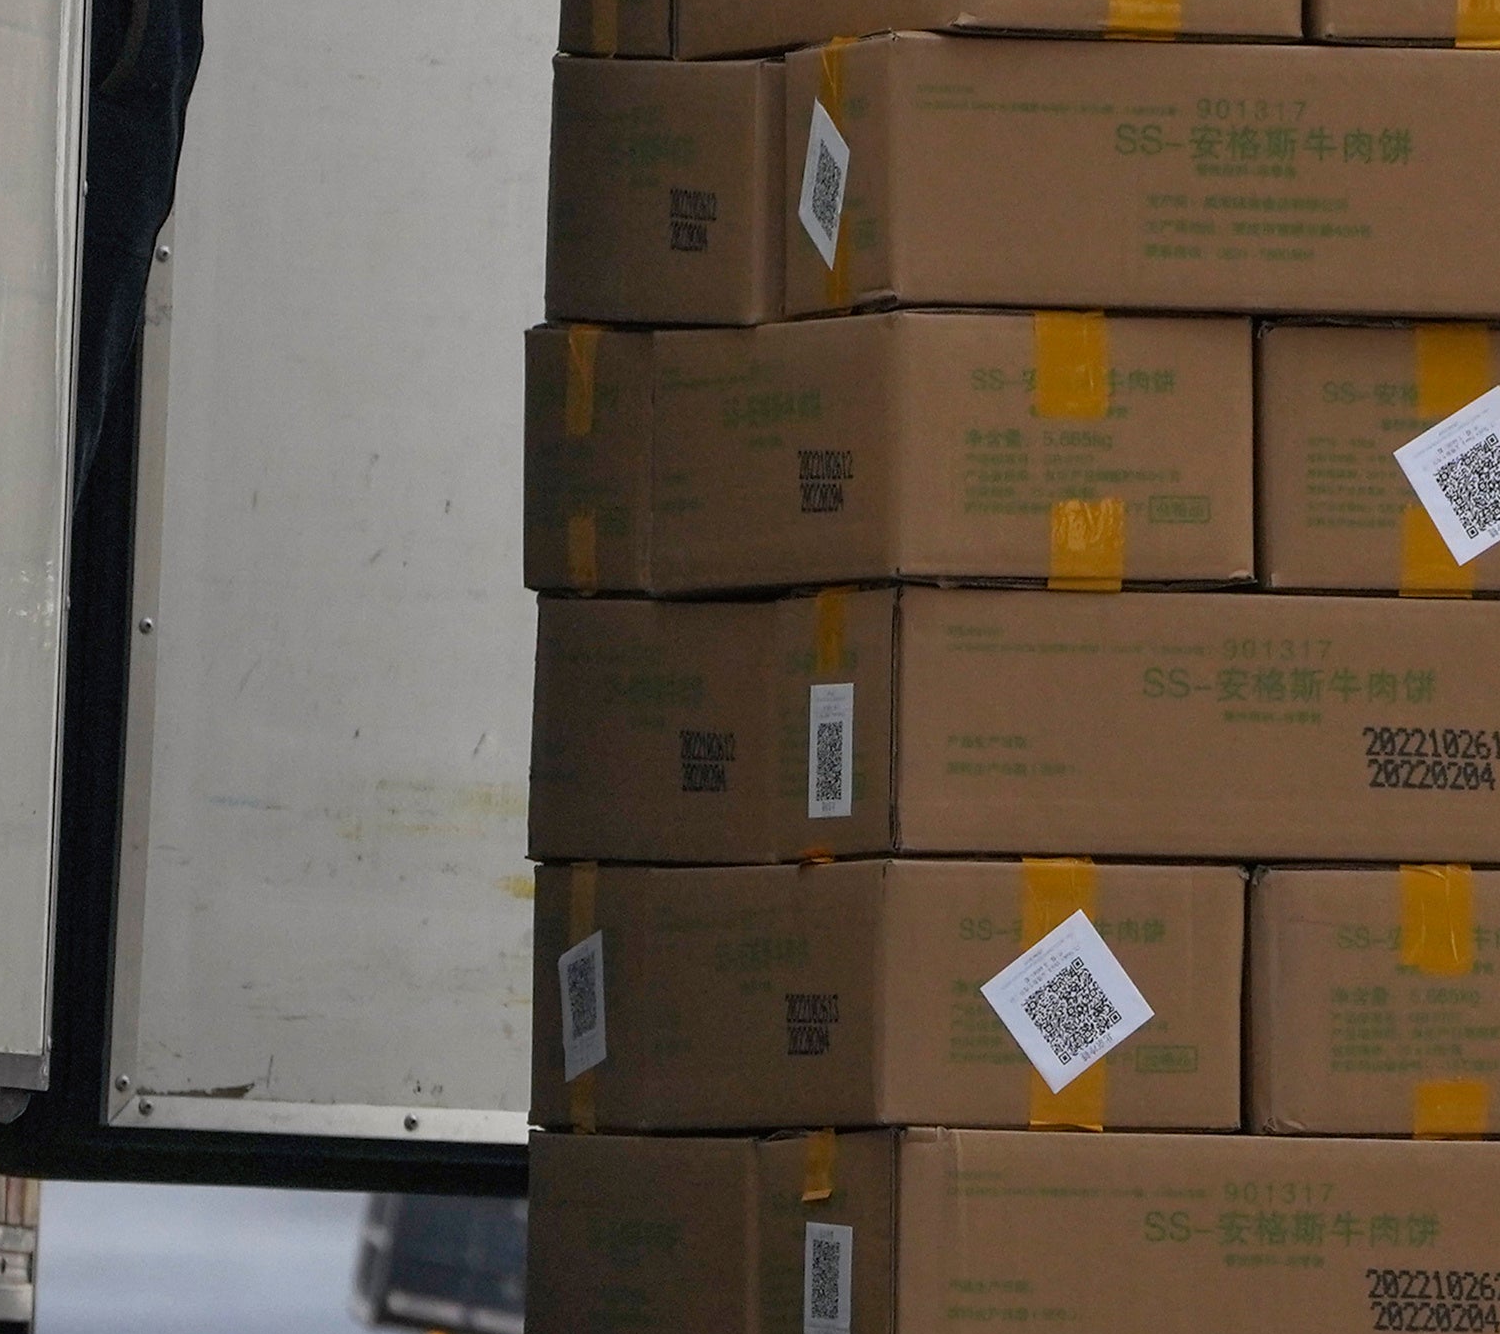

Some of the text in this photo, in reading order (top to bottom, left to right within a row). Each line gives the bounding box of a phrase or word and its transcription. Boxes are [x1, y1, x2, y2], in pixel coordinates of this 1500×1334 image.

[1195, 98, 1309, 122] 901317
[1113, 123, 1413, 165] SS-安格斯牛肉饼
[1222, 638, 1334, 661] 901317
[1141, 666, 1437, 706] SS-安格斯牛肉饼
[1367, 759, 1497, 792] 20220204
[1223, 1182, 1336, 1205] 901317
[1143, 1209, 1441, 1248] SS-安格斯牛肉饼
[1371, 1300, 1500, 1334] 20220204
